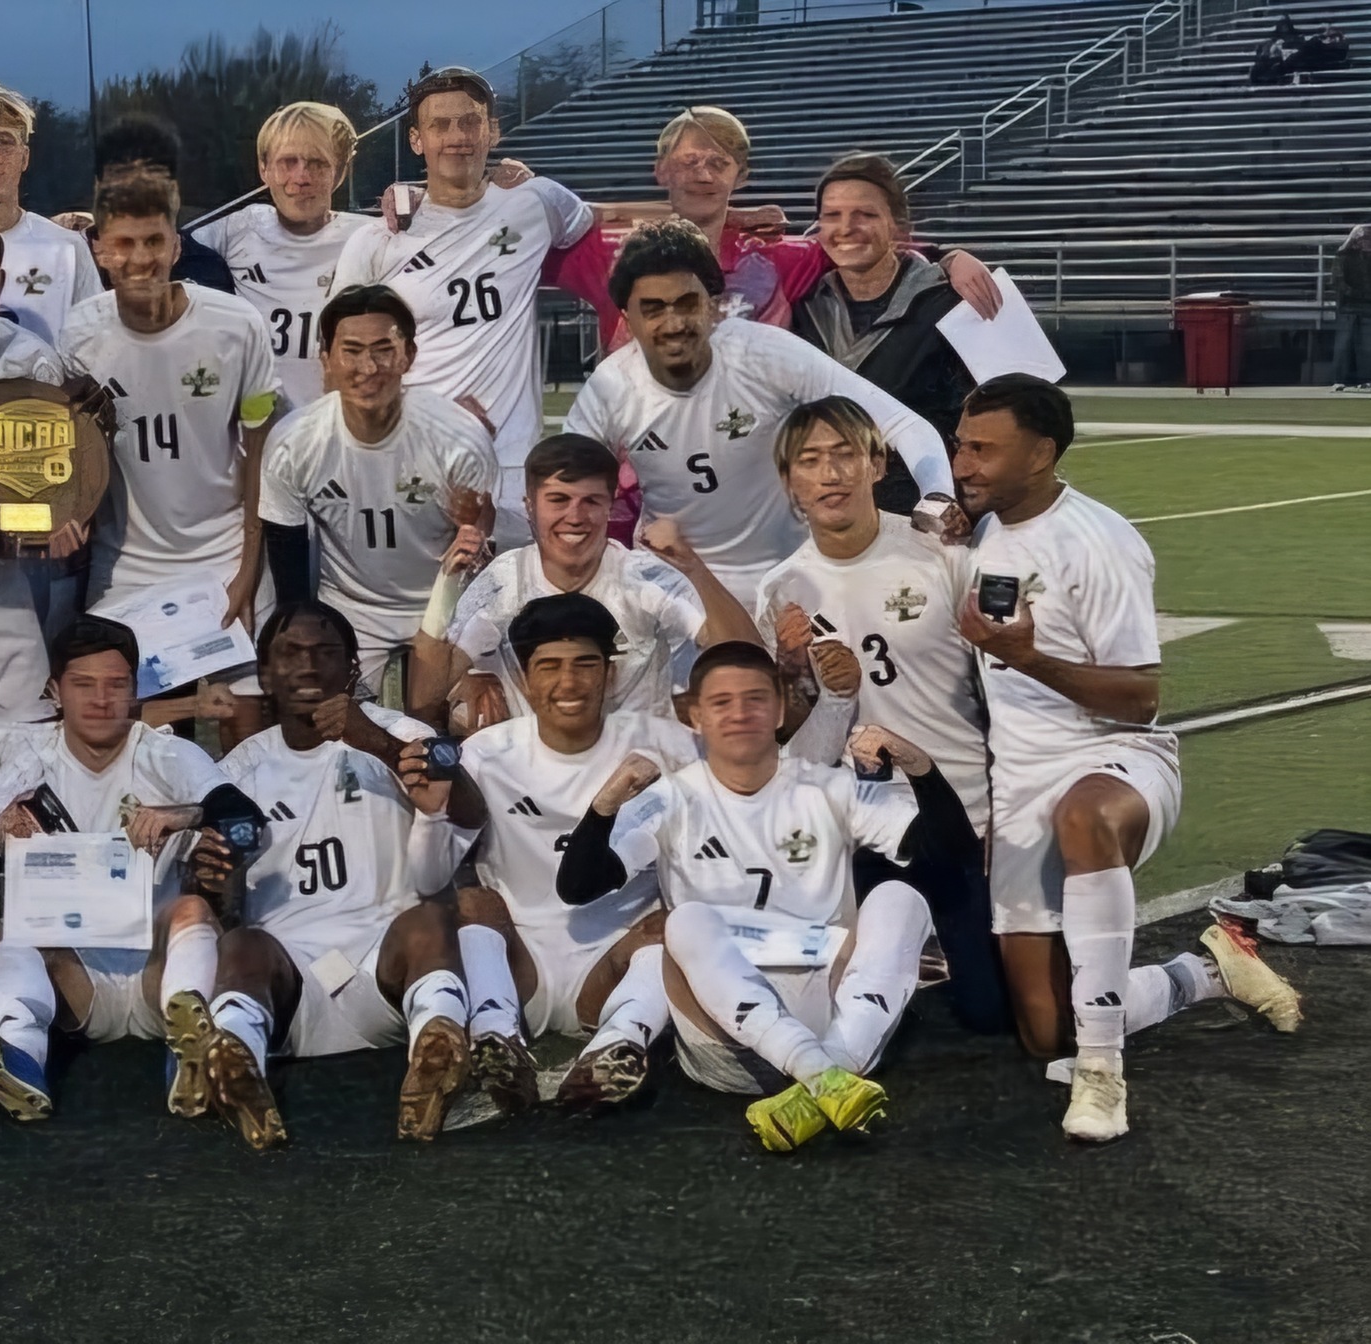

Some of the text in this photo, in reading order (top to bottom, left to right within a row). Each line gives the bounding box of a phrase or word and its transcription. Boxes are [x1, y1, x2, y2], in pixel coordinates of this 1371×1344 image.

[447, 271, 503, 328] 26
[270, 307, 313, 359] 31
[131, 413, 180, 463] 14
[686, 452, 719, 494] 5
[359, 508, 396, 549] 11
[861, 633, 898, 687] 3
[296, 836, 348, 895] 50
[745, 868, 774, 911] 7
